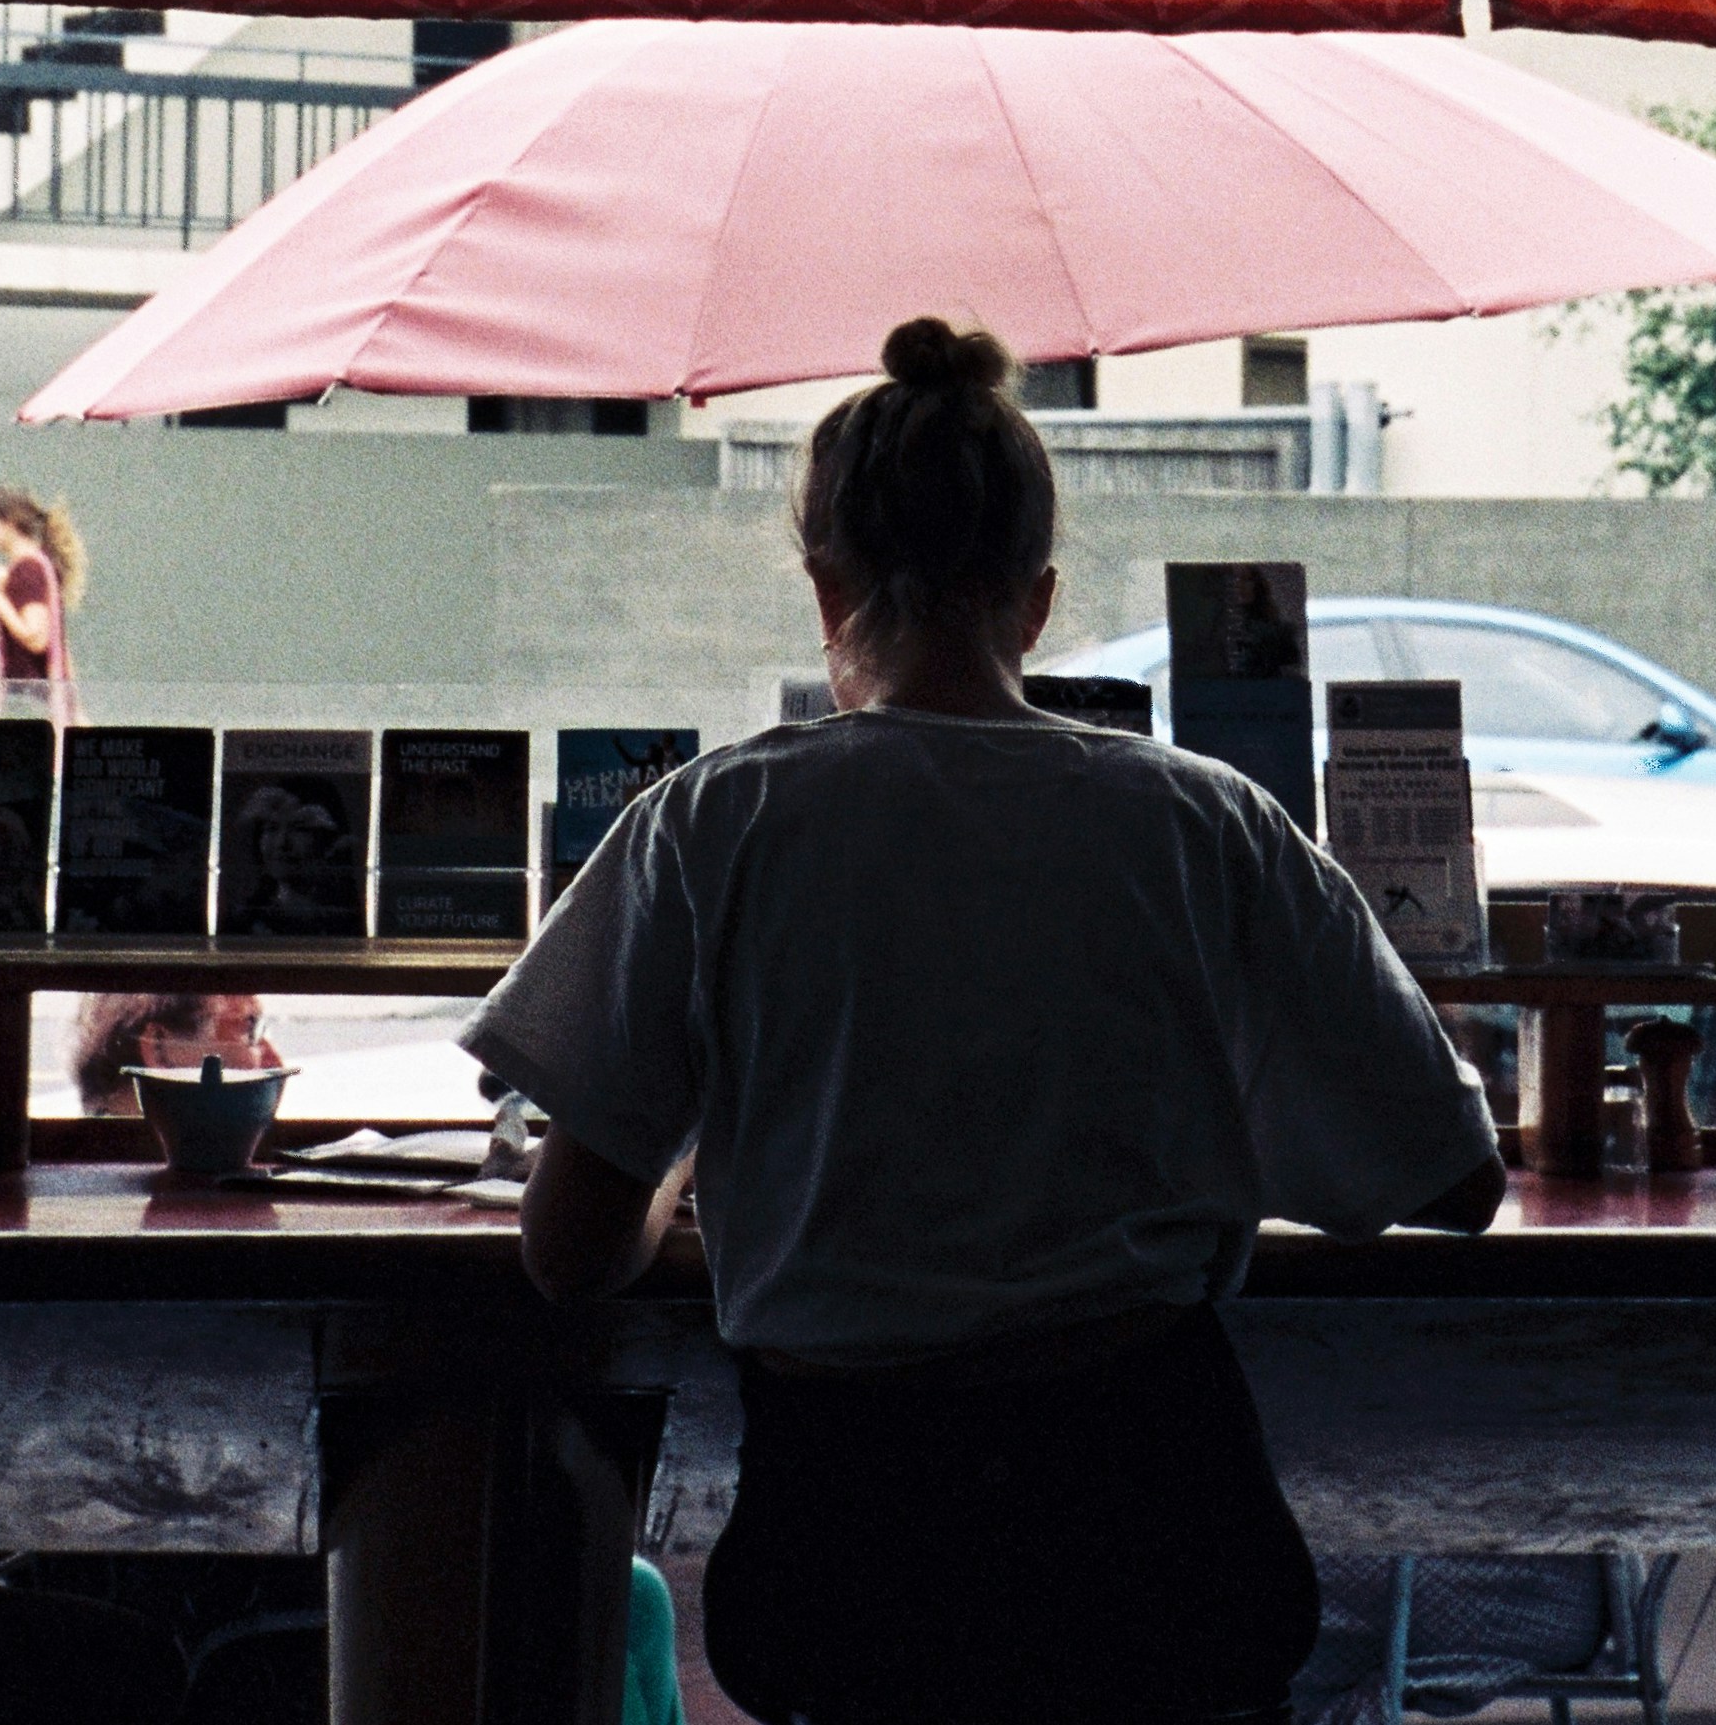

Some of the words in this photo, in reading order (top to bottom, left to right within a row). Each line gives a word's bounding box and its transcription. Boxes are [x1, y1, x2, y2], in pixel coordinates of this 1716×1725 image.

[243, 742, 358, 760] EXCHANGE
[398, 742, 502, 758] UNDERSTAND
[396, 896, 453, 911] CURATE
